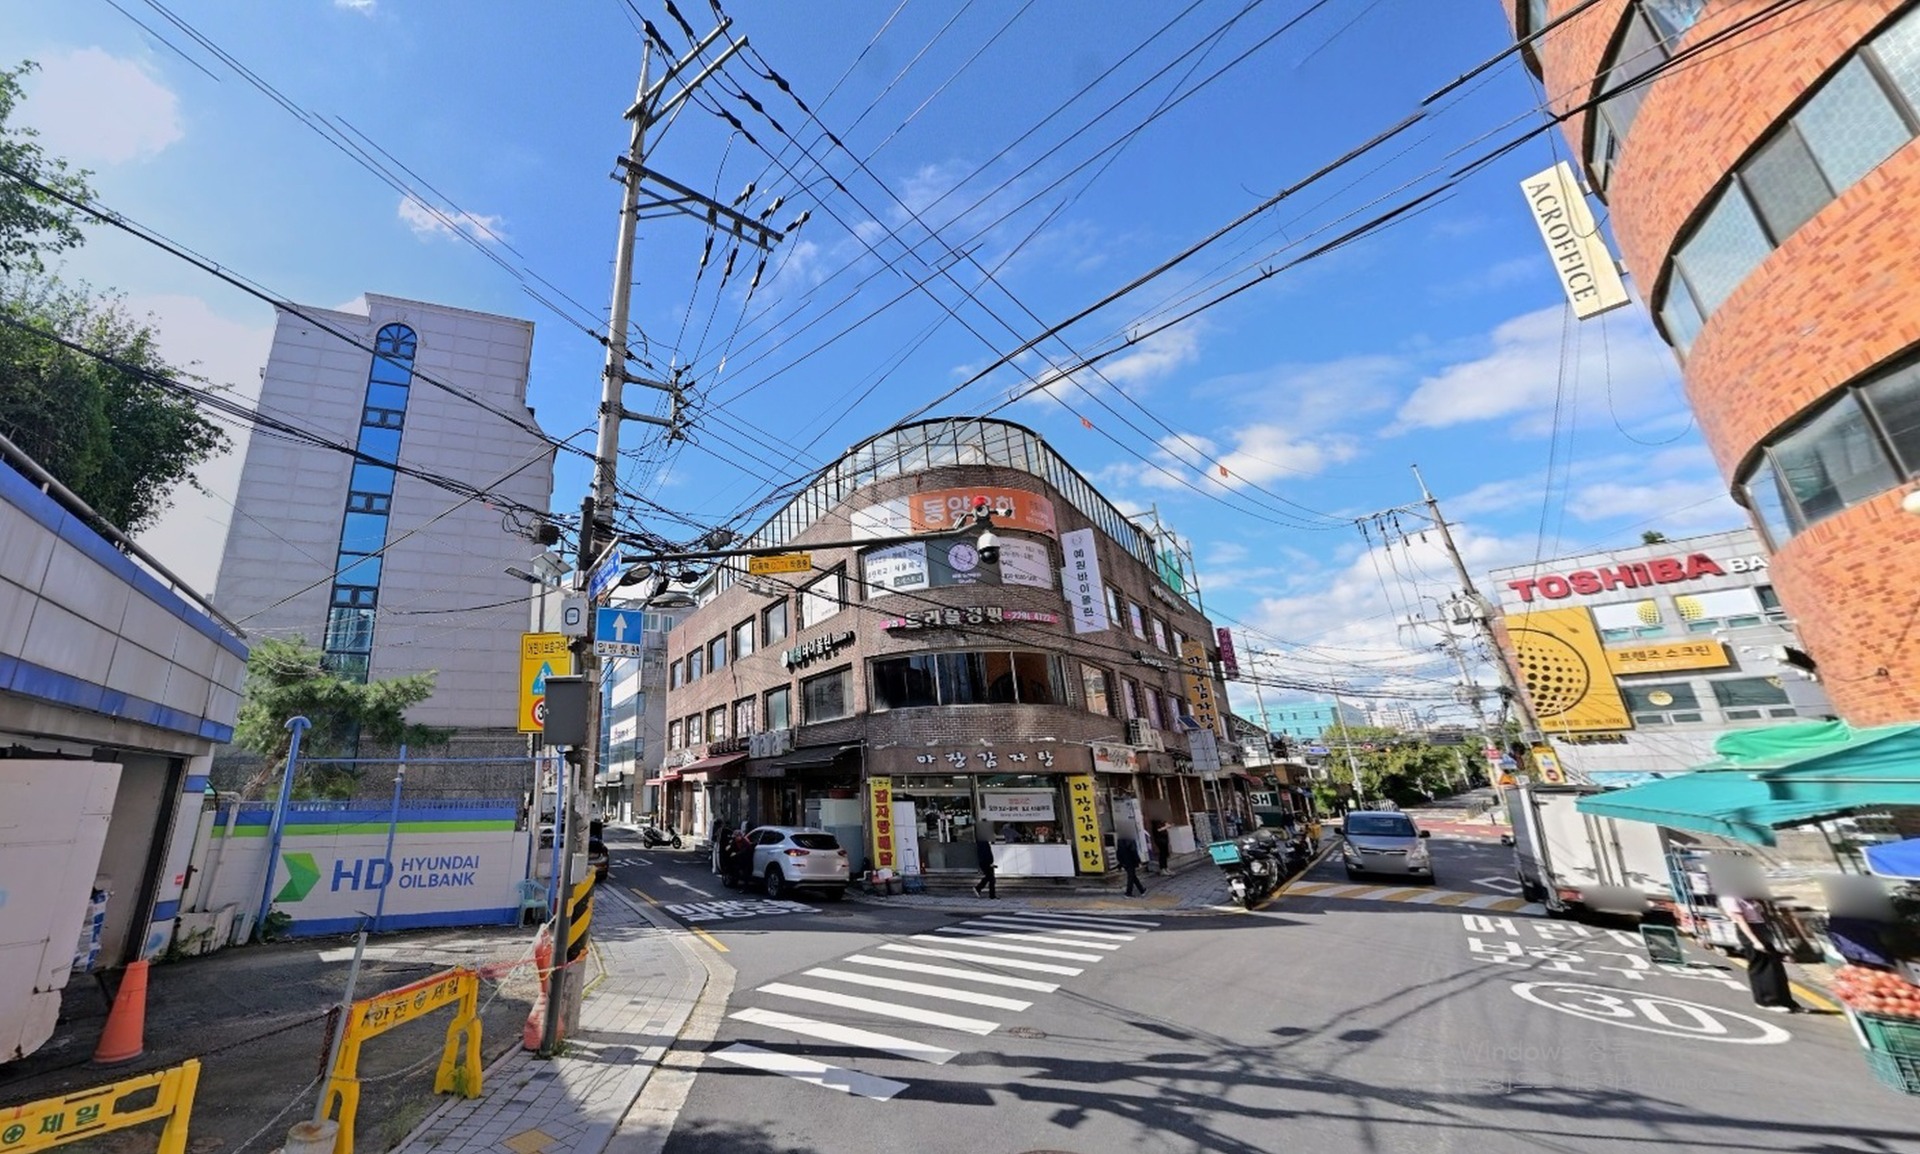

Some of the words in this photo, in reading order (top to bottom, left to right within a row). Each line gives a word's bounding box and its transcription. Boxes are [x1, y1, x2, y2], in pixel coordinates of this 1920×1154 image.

[1528, 182, 1597, 302] ACROFFICE
[1508, 553, 1726, 602] TOSHIBA
[597, 642, 640, 656] 일방통행
[1618, 649, 1661, 661] 프렌즈
[1665, 645, 1711, 658] 스크린
[916, 750, 1054, 769] 마장감자탕
[1074, 782, 1098, 866] 마장감자탕
[331, 858, 393, 892] HD
[401, 855, 479, 872] HYUNDAI
[399, 872, 475, 890] OILBANK
[1554, 988, 1729, 1034] 30
[38, 1104, 100, 1135] 제일
